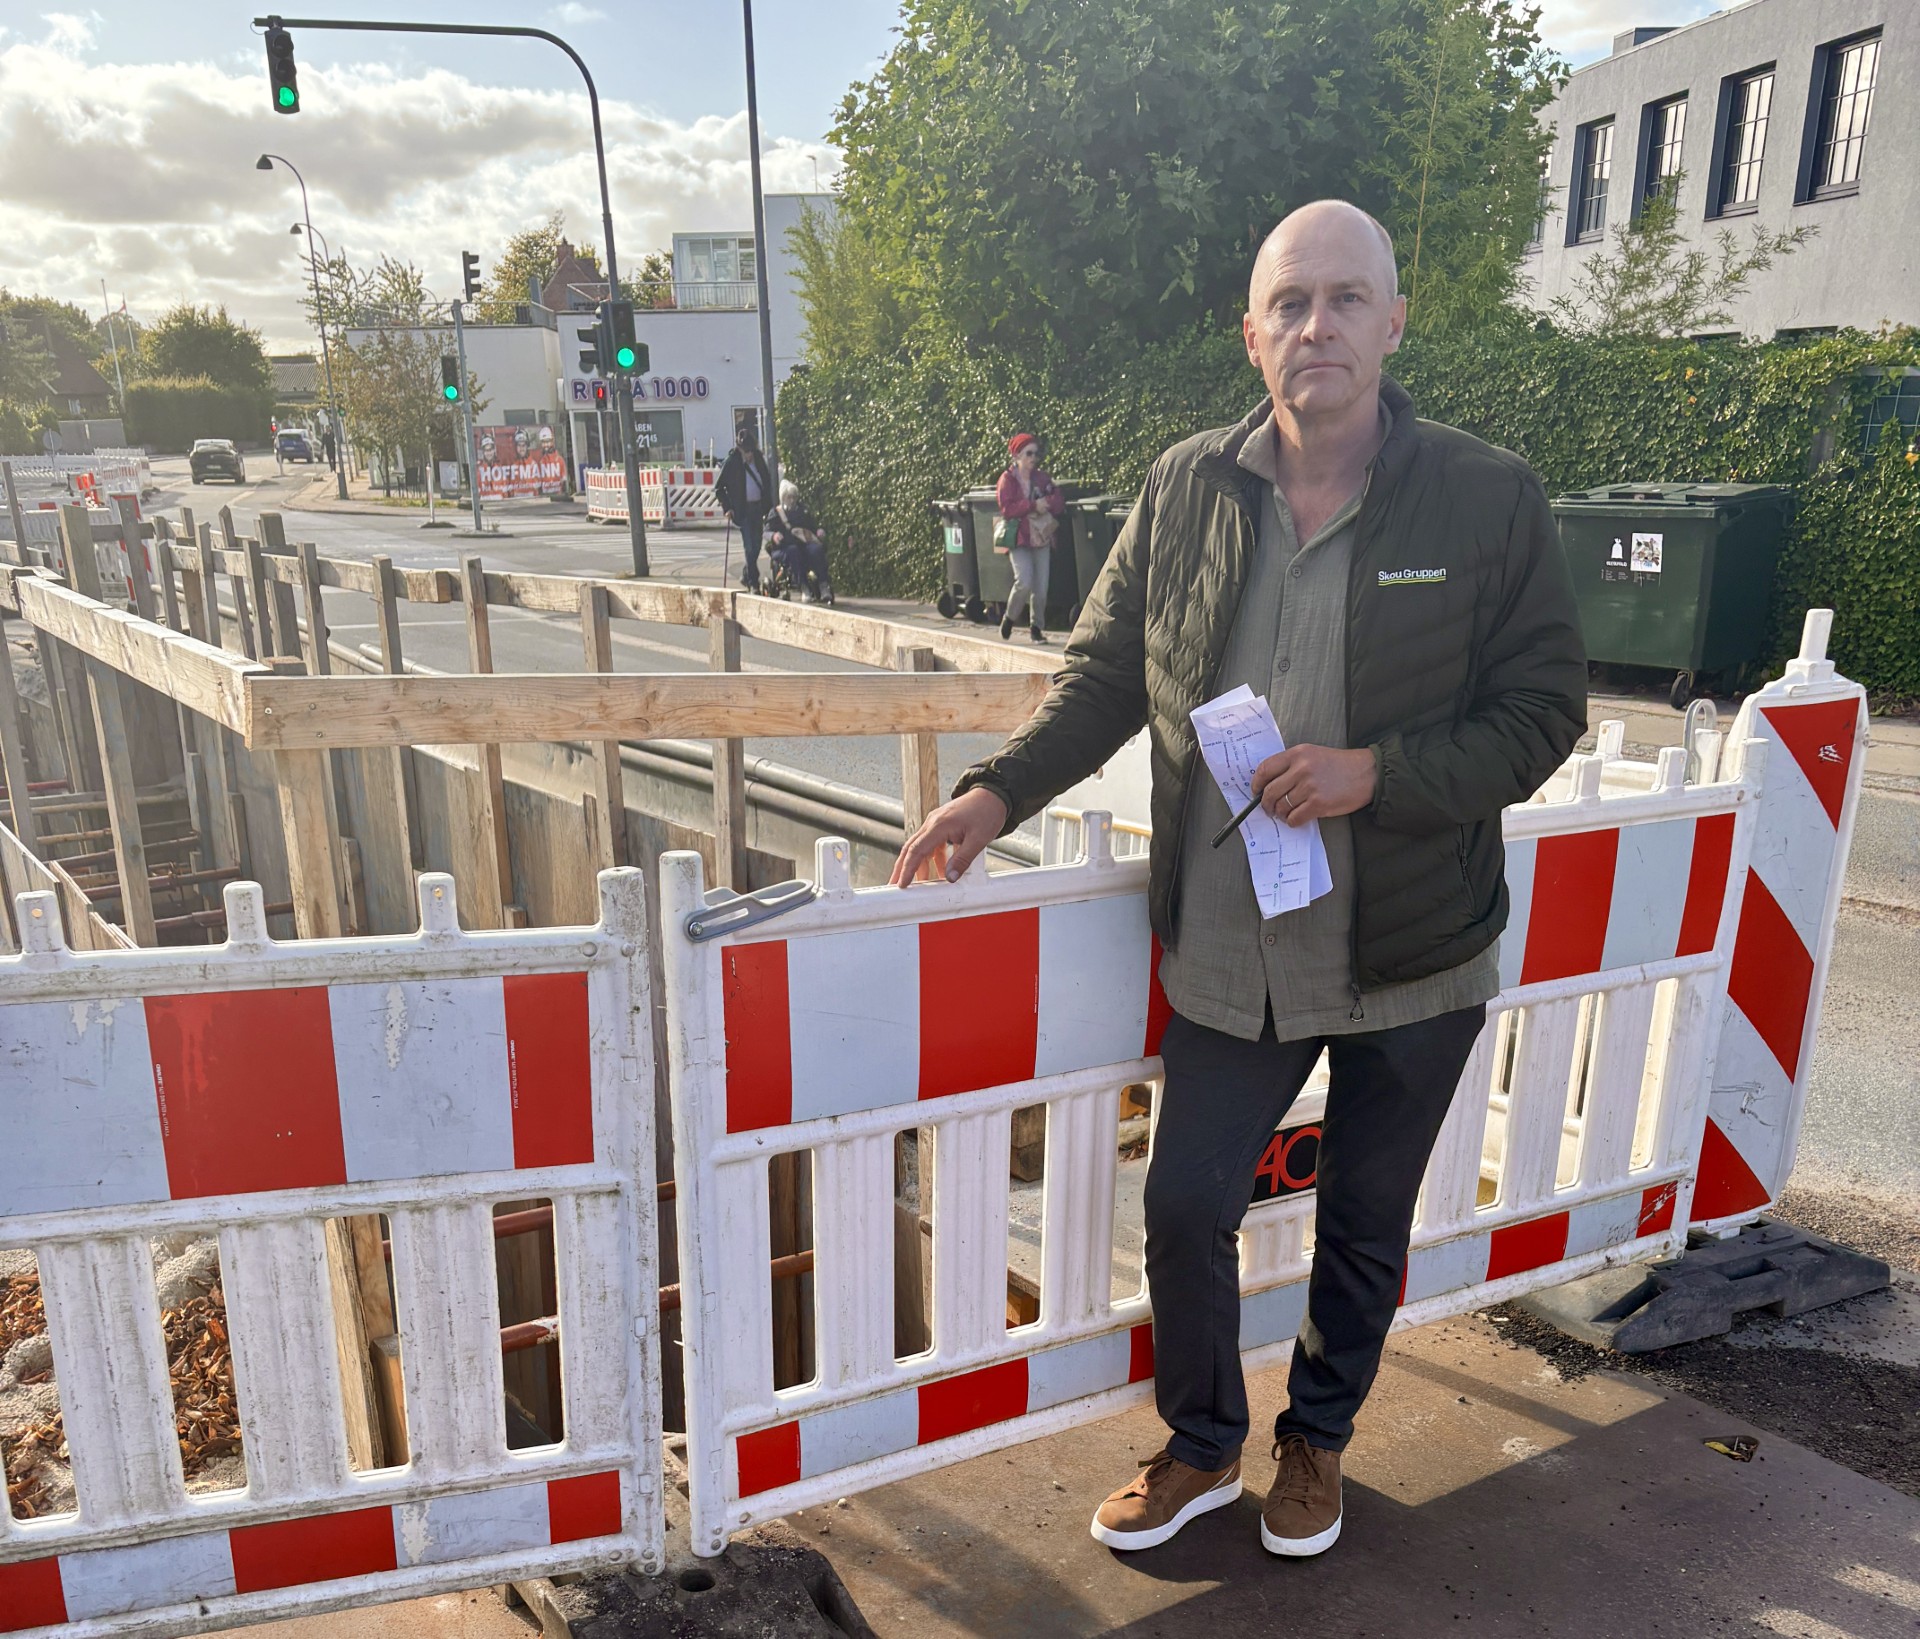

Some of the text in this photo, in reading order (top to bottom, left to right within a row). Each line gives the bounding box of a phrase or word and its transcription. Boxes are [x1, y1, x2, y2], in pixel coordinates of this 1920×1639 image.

[653, 378, 708, 398] 1000
[479, 461, 561, 482] HOFFMANN
[1378, 568, 1447, 580] Skou Gruppen
